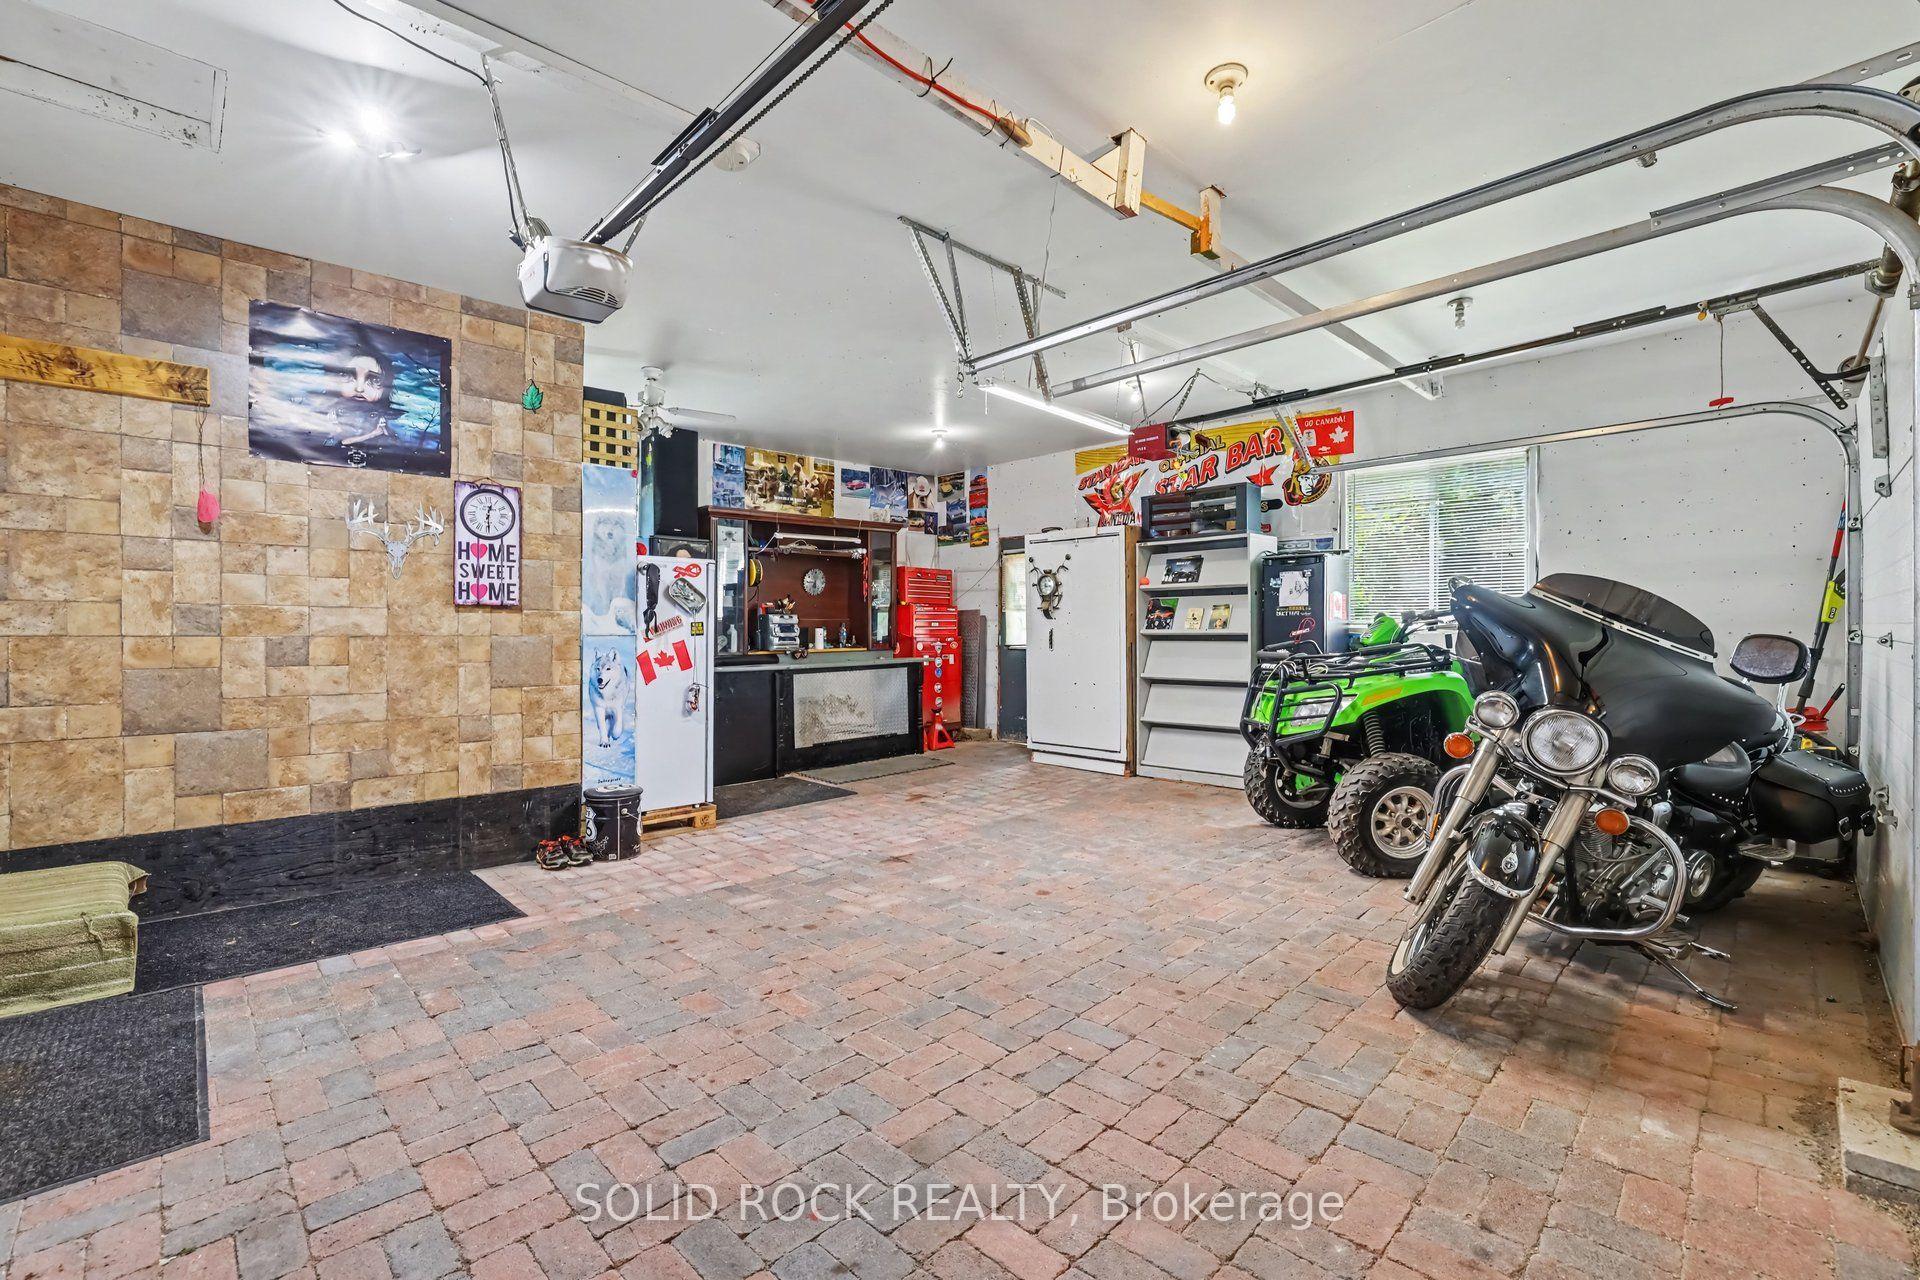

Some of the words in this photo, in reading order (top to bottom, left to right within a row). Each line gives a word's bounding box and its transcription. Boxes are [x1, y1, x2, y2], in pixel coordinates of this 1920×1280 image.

[1315, 415, 1346, 426] CANADA!
[1155, 454, 1218, 495] STAR
[1225, 426, 1286, 473] BAR
[459, 563, 515, 580] SWEET
